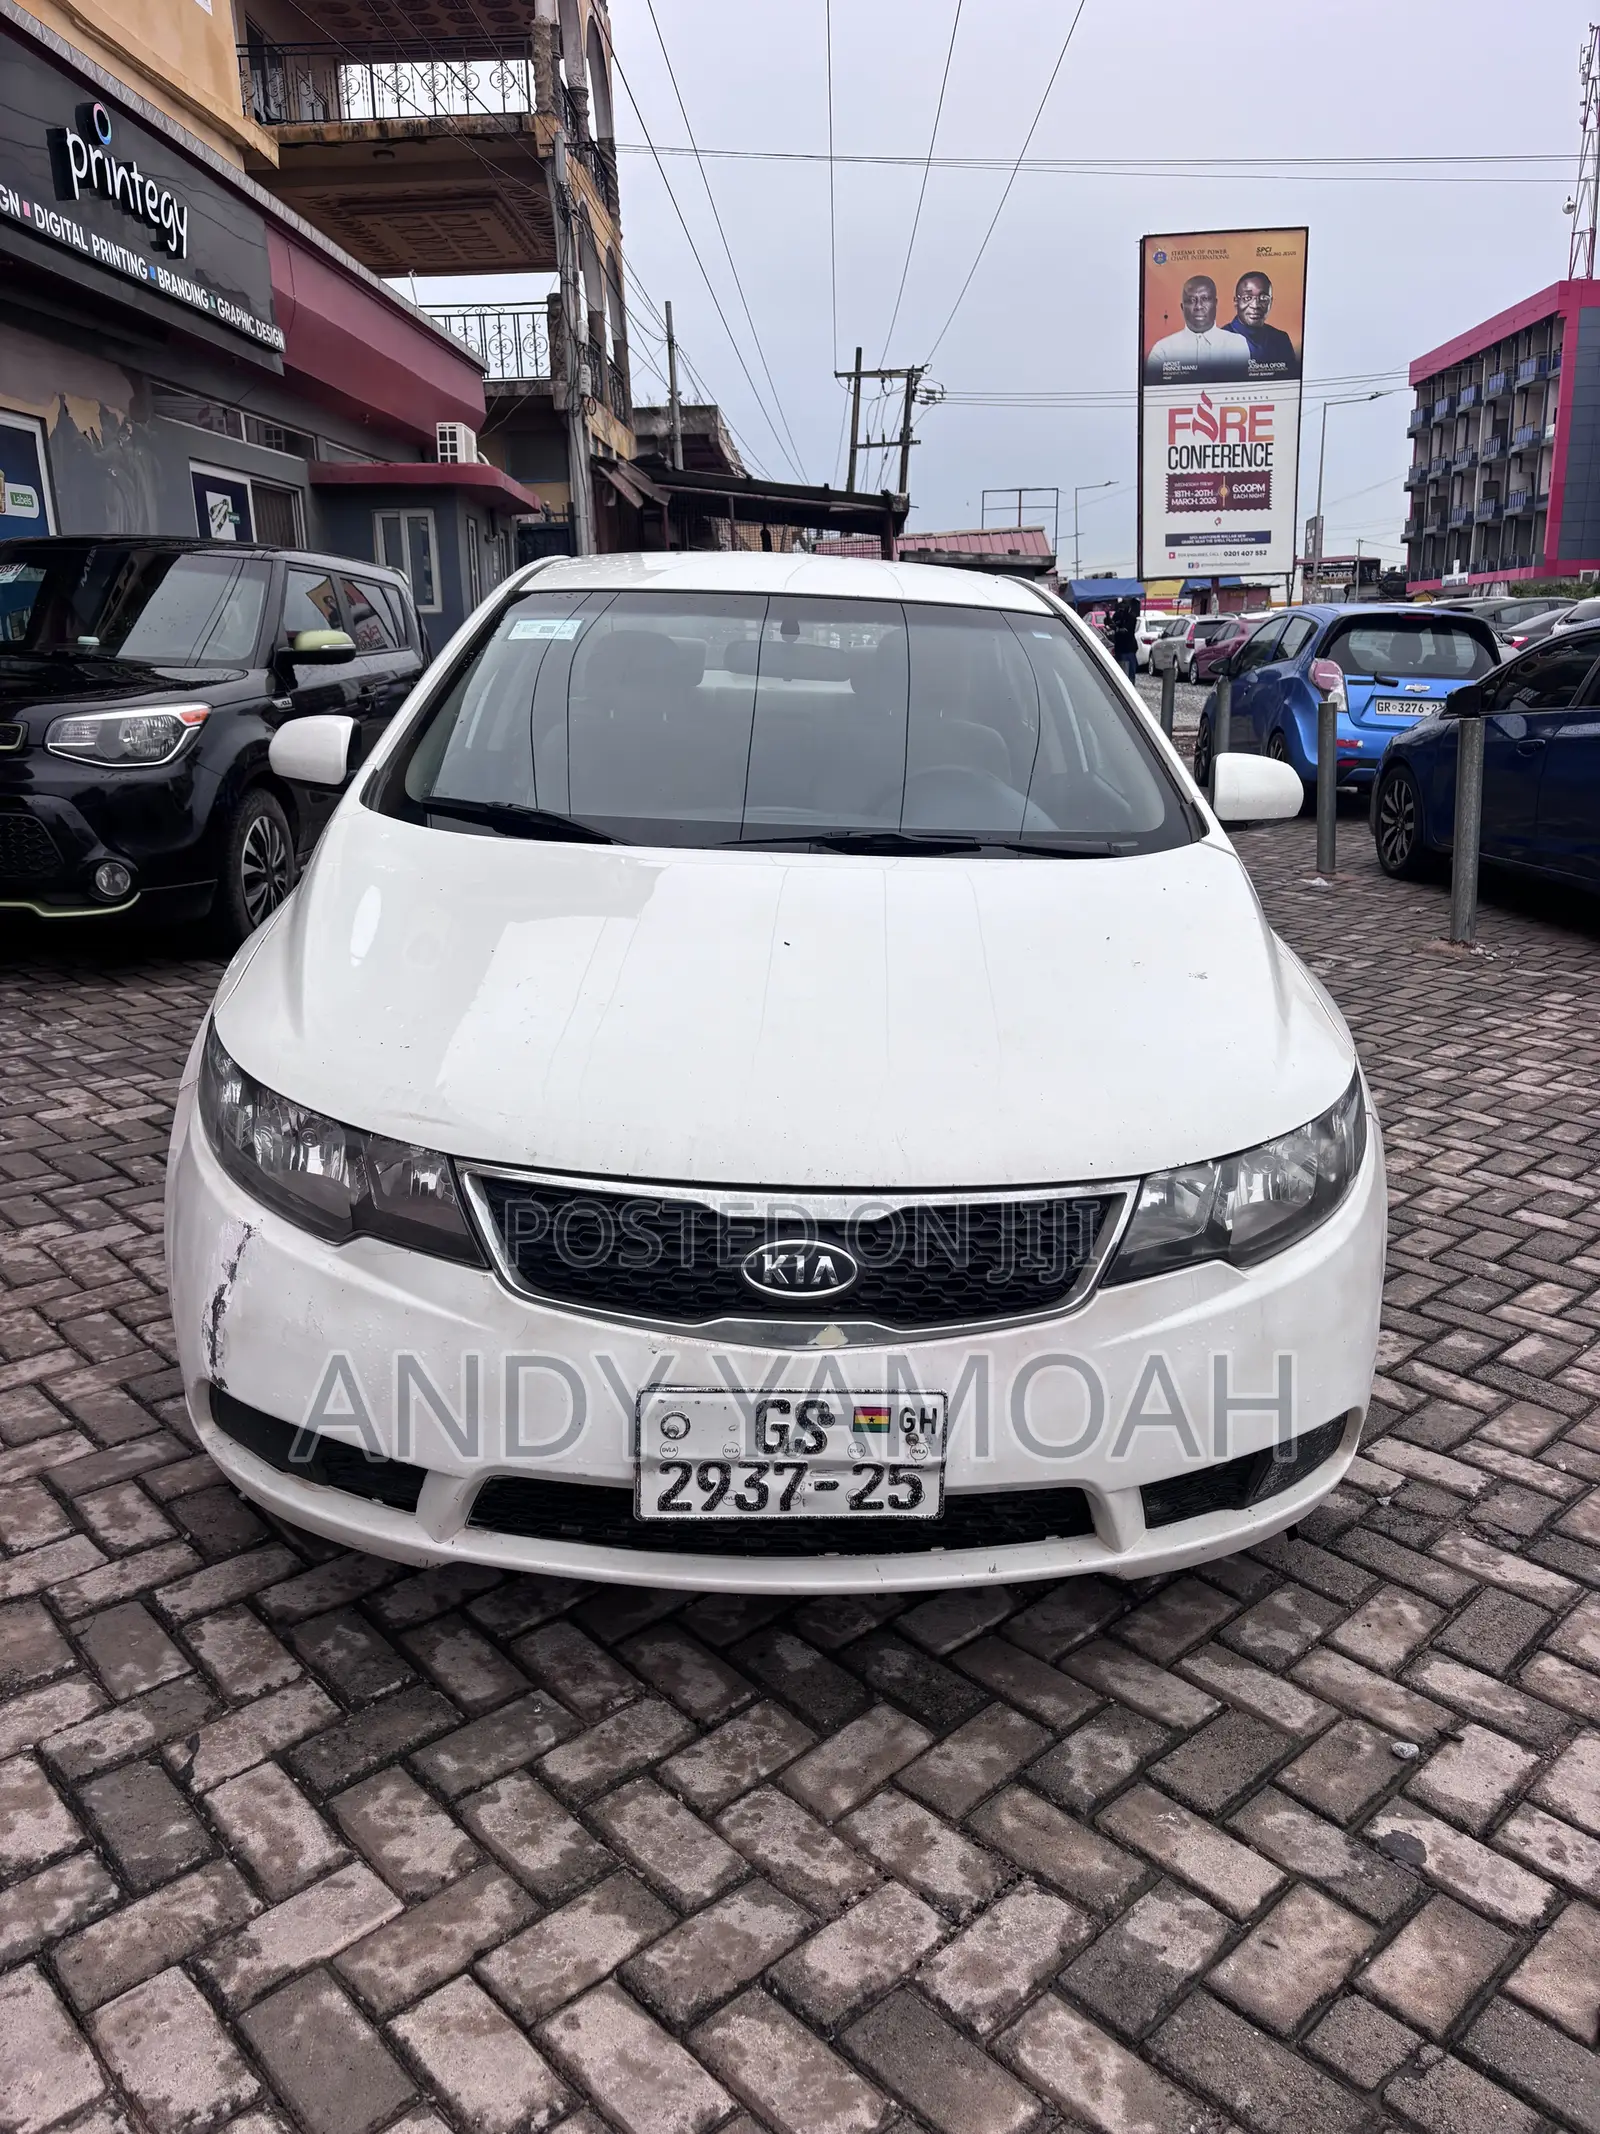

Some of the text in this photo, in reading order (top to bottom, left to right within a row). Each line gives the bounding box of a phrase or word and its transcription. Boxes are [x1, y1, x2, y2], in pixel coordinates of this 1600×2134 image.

[66, 101, 188, 259] printegy
[34, 203, 88, 251] DIGITAL
[91, 233, 148, 280] PRINTING
[158, 266, 209, 309] BRANDING
[217, 297, 255, 334] GRAPHIC
[255, 322, 285, 350] DESIGN
[1168, 443, 1274, 470] CONFERENCE
[12, 493, 32, 506] Labels
[1199, 497, 1217, 505] 2026
[1232, 483, 1265, 493] 6:00PM
[1377, 702, 1391, 713] GR
[761, 1252, 839, 1286] KIA
[755, 1398, 938, 1456] GS GH
